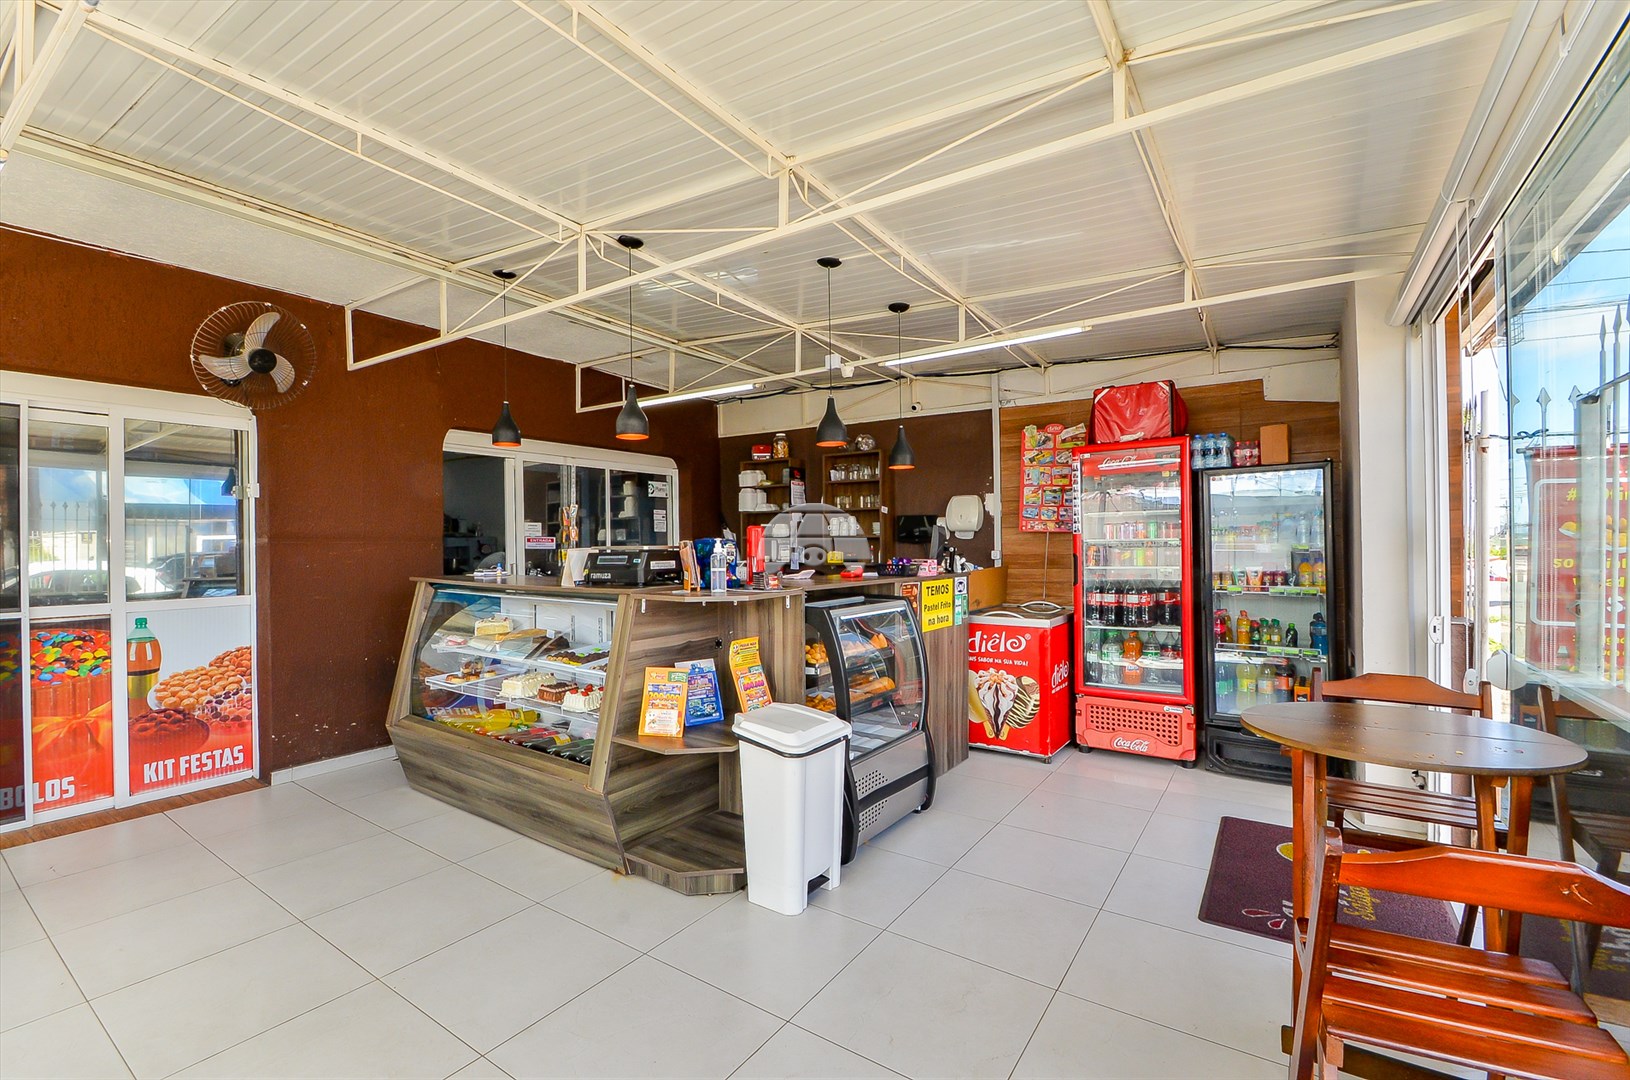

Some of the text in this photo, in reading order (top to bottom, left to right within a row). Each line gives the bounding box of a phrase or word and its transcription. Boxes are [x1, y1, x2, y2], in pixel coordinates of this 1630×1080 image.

[926, 584, 950, 597] TEMOS
[924, 601, 952, 613] Pastel Frito
[928, 614, 950, 626] na hora
[968, 631, 1027, 653] diêlo
[143, 745, 244, 784] KIT FESTAS
